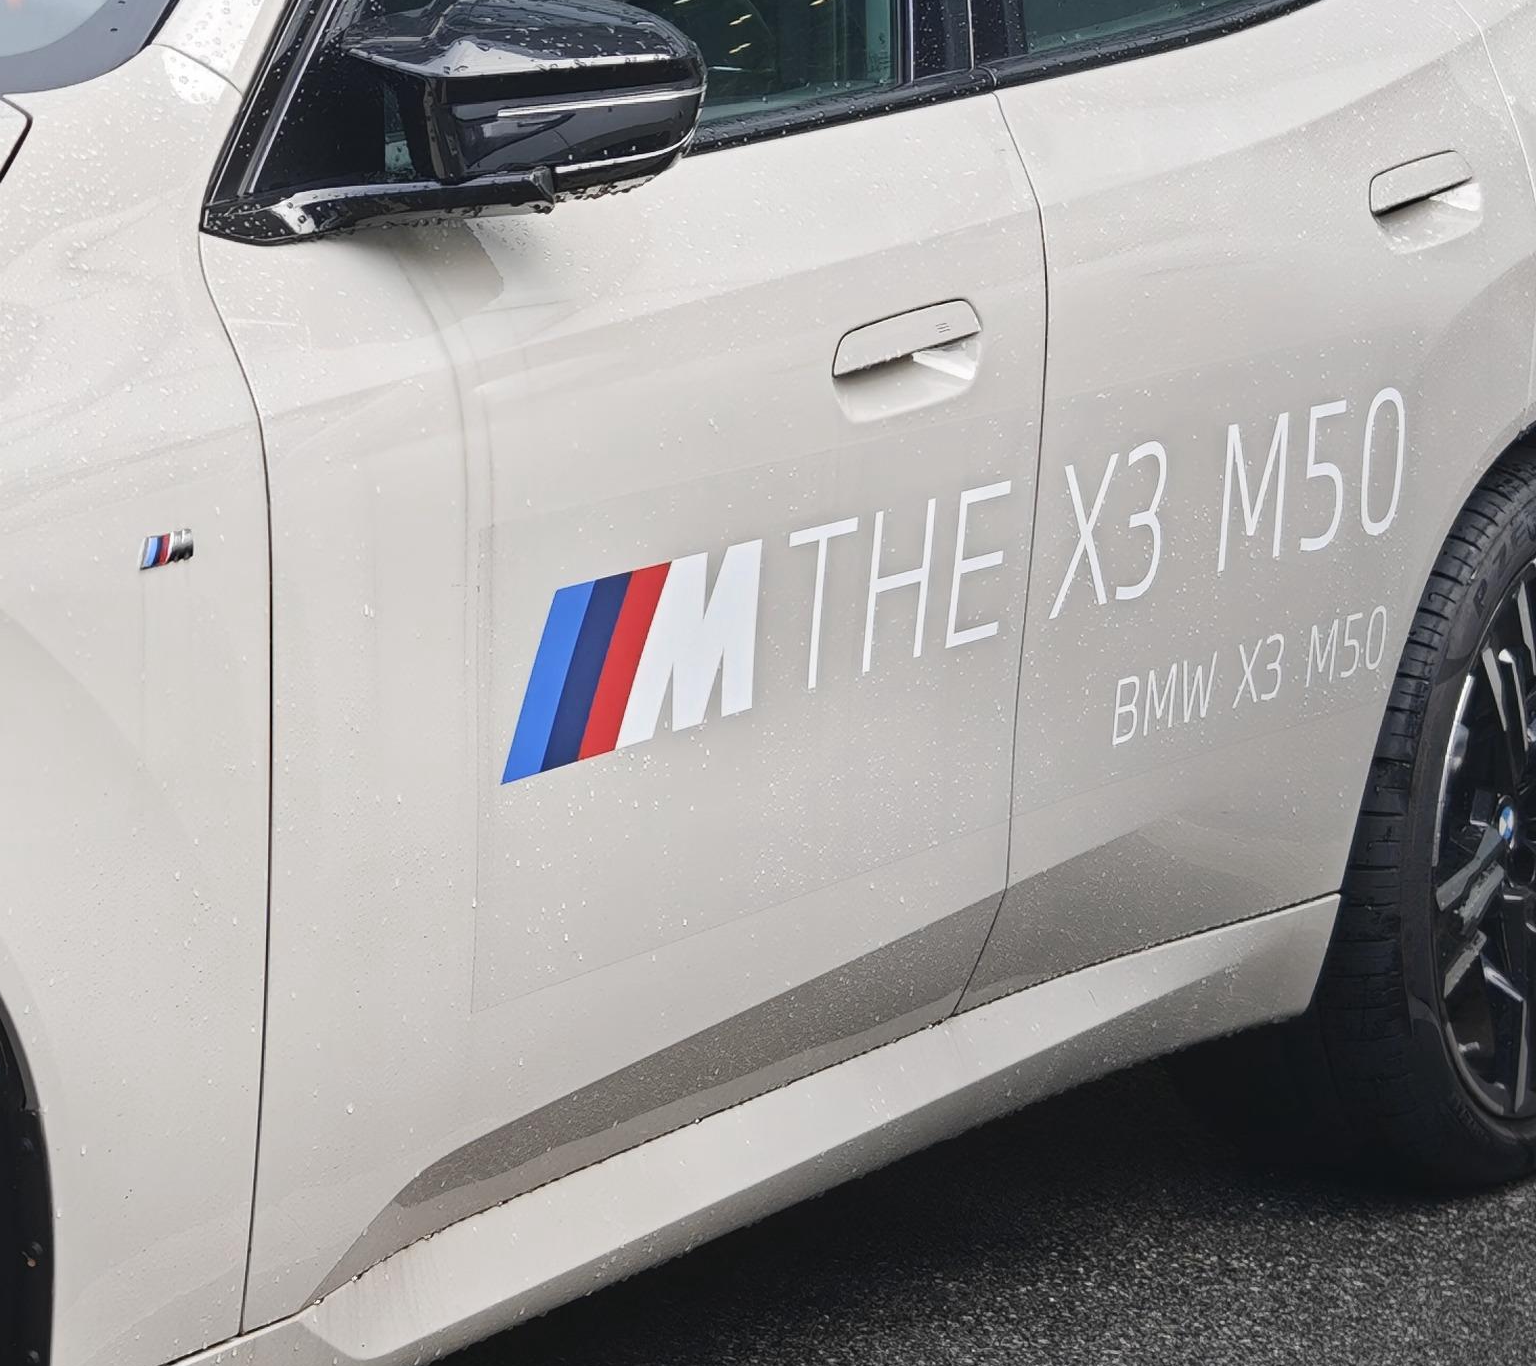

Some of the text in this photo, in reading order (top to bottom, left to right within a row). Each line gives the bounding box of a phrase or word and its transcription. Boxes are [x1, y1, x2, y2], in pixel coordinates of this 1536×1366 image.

[789, 479, 1012, 690] THE
[1048, 440, 1168, 620] X3
[1216, 387, 1406, 575] M50
[1111, 605, 1389, 746] BMW X3 M50
